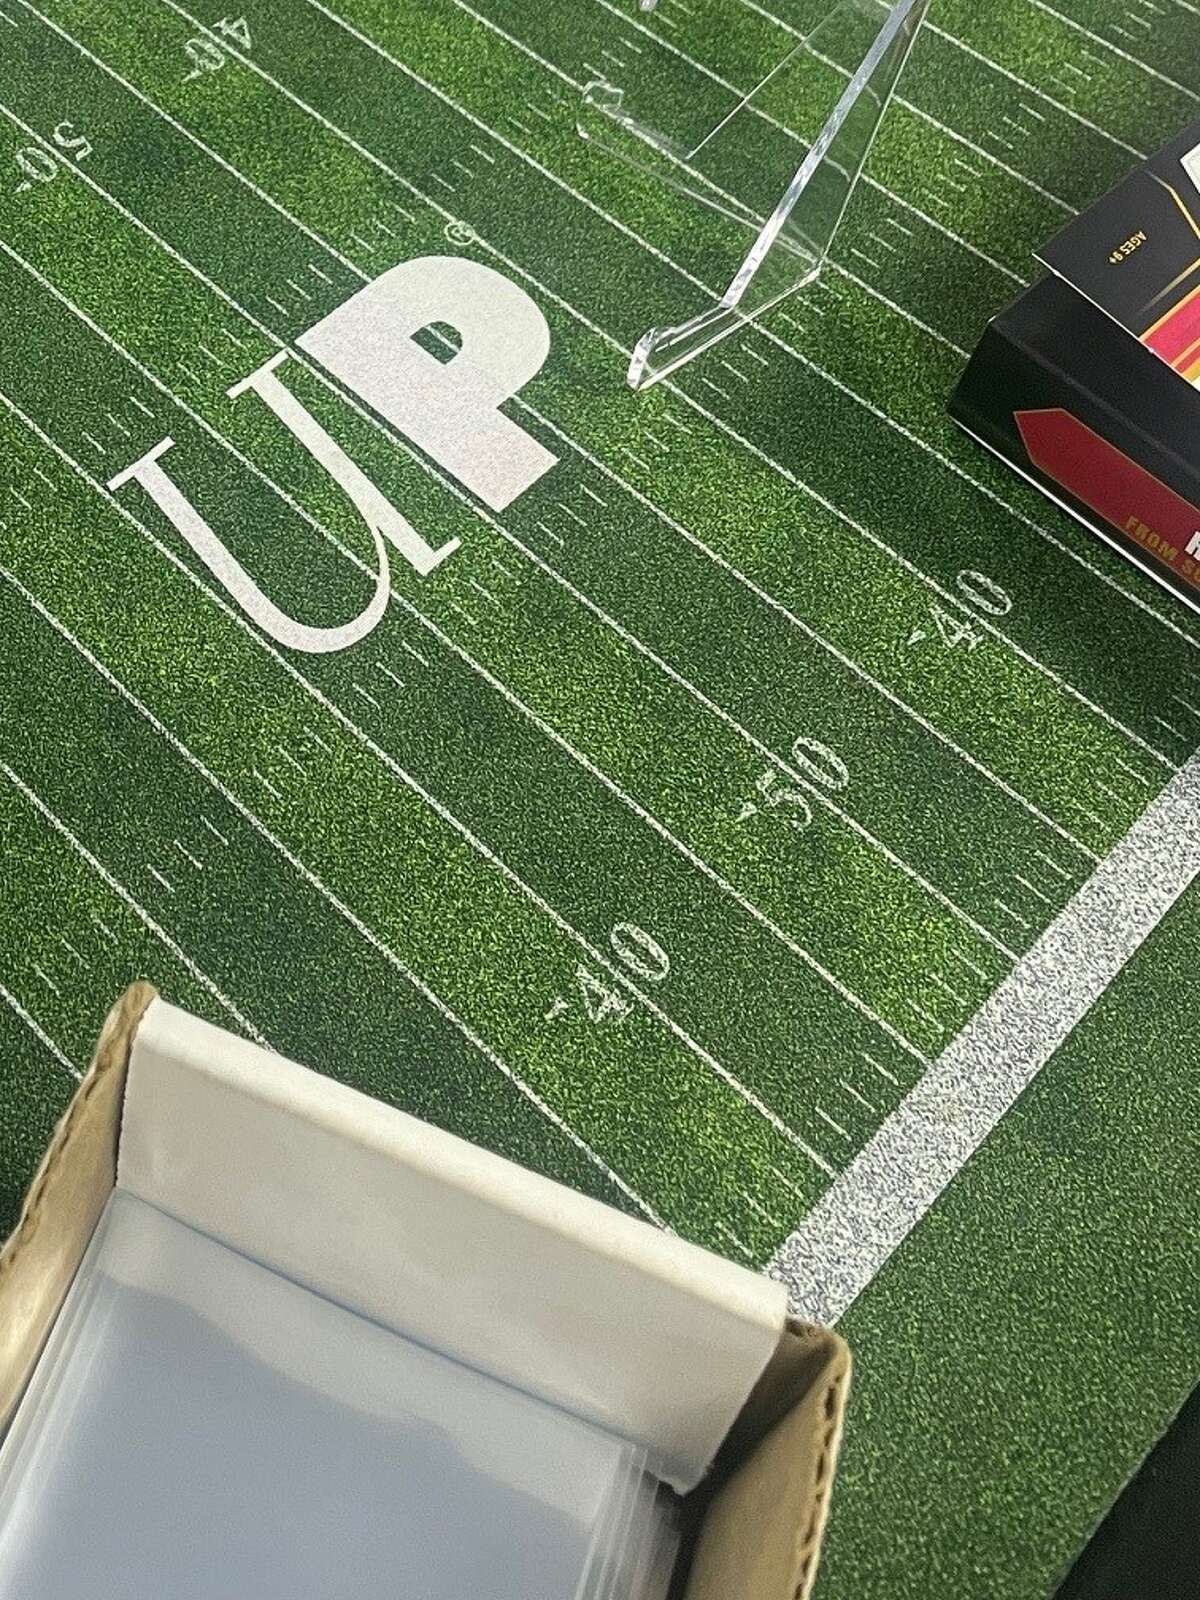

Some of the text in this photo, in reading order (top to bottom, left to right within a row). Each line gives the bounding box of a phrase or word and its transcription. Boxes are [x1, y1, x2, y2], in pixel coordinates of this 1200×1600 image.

[184, 14, 257, 71] 40
[15, 120, 94, 185] 50
[928, 569, 1012, 650] 40
[756, 736, 850, 830] 50
[575, 922, 671, 1025] 40
